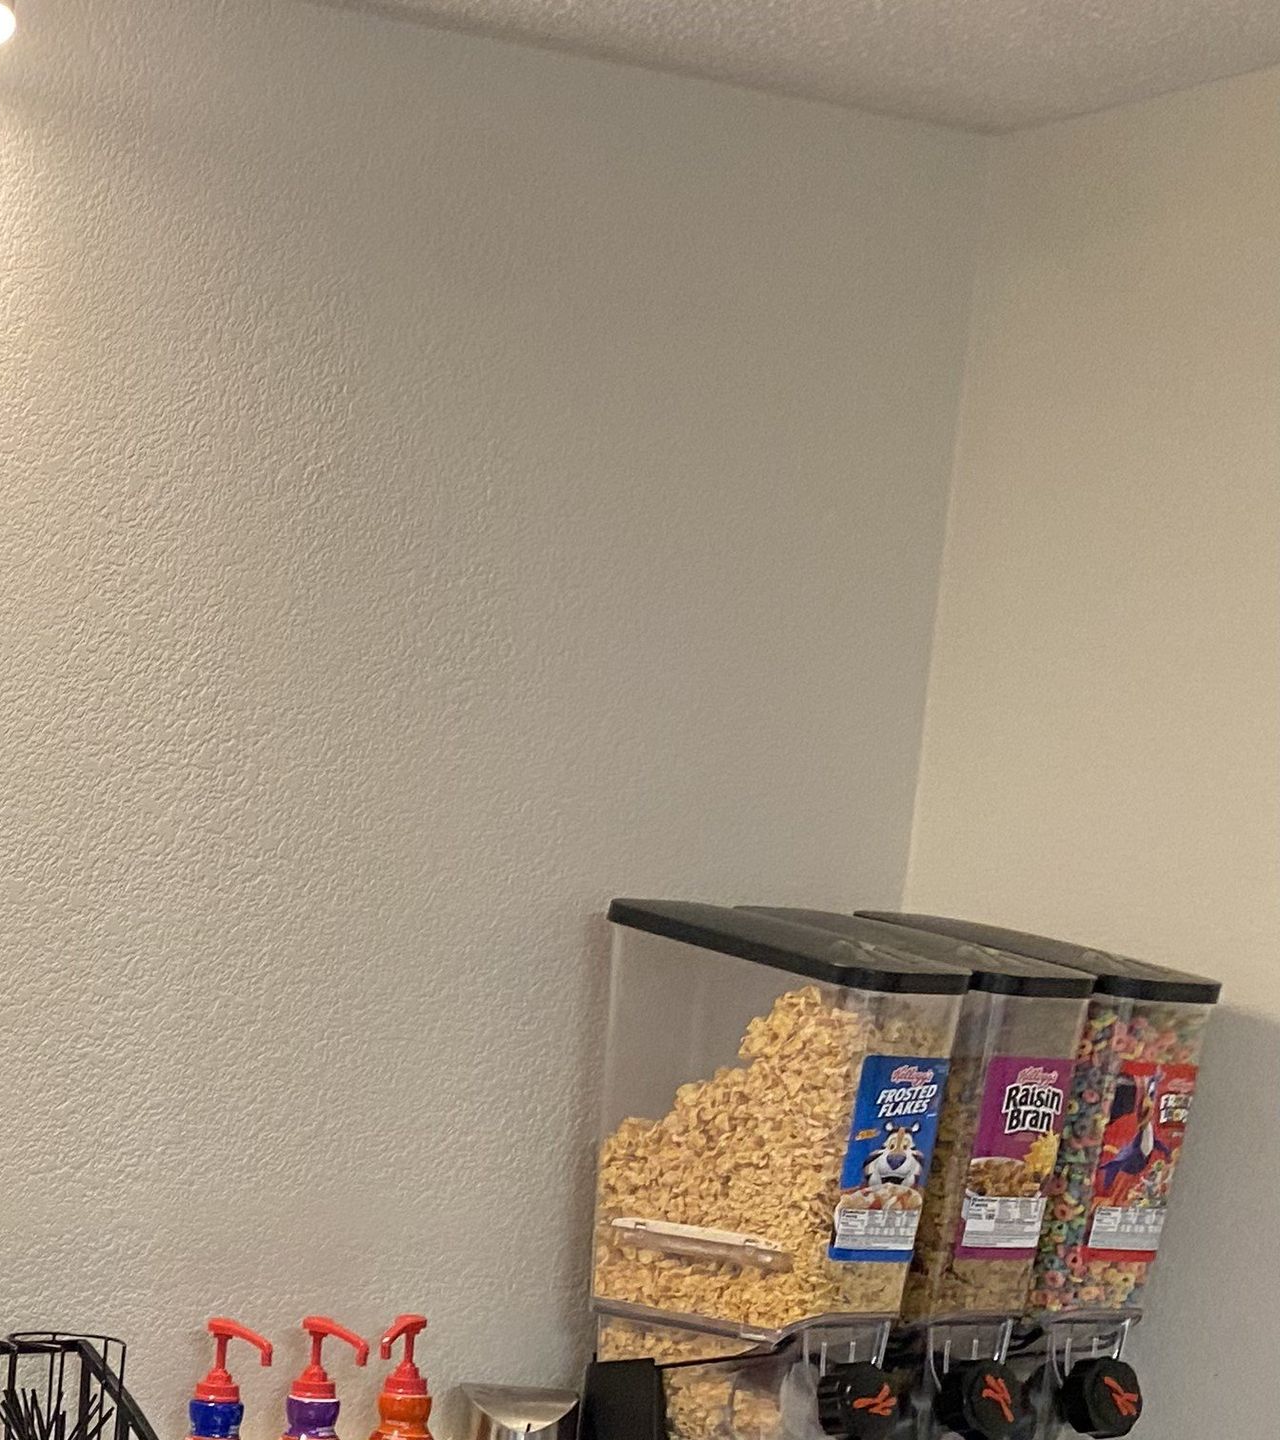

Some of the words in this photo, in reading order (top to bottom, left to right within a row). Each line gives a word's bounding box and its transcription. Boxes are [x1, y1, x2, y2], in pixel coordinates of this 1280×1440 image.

[877, 1084, 938, 1104] FROSTED
[1004, 1085, 1063, 1113] Raisin
[877, 1100, 930, 1118] FLAKES
[1007, 1107, 1053, 1132] Bran
